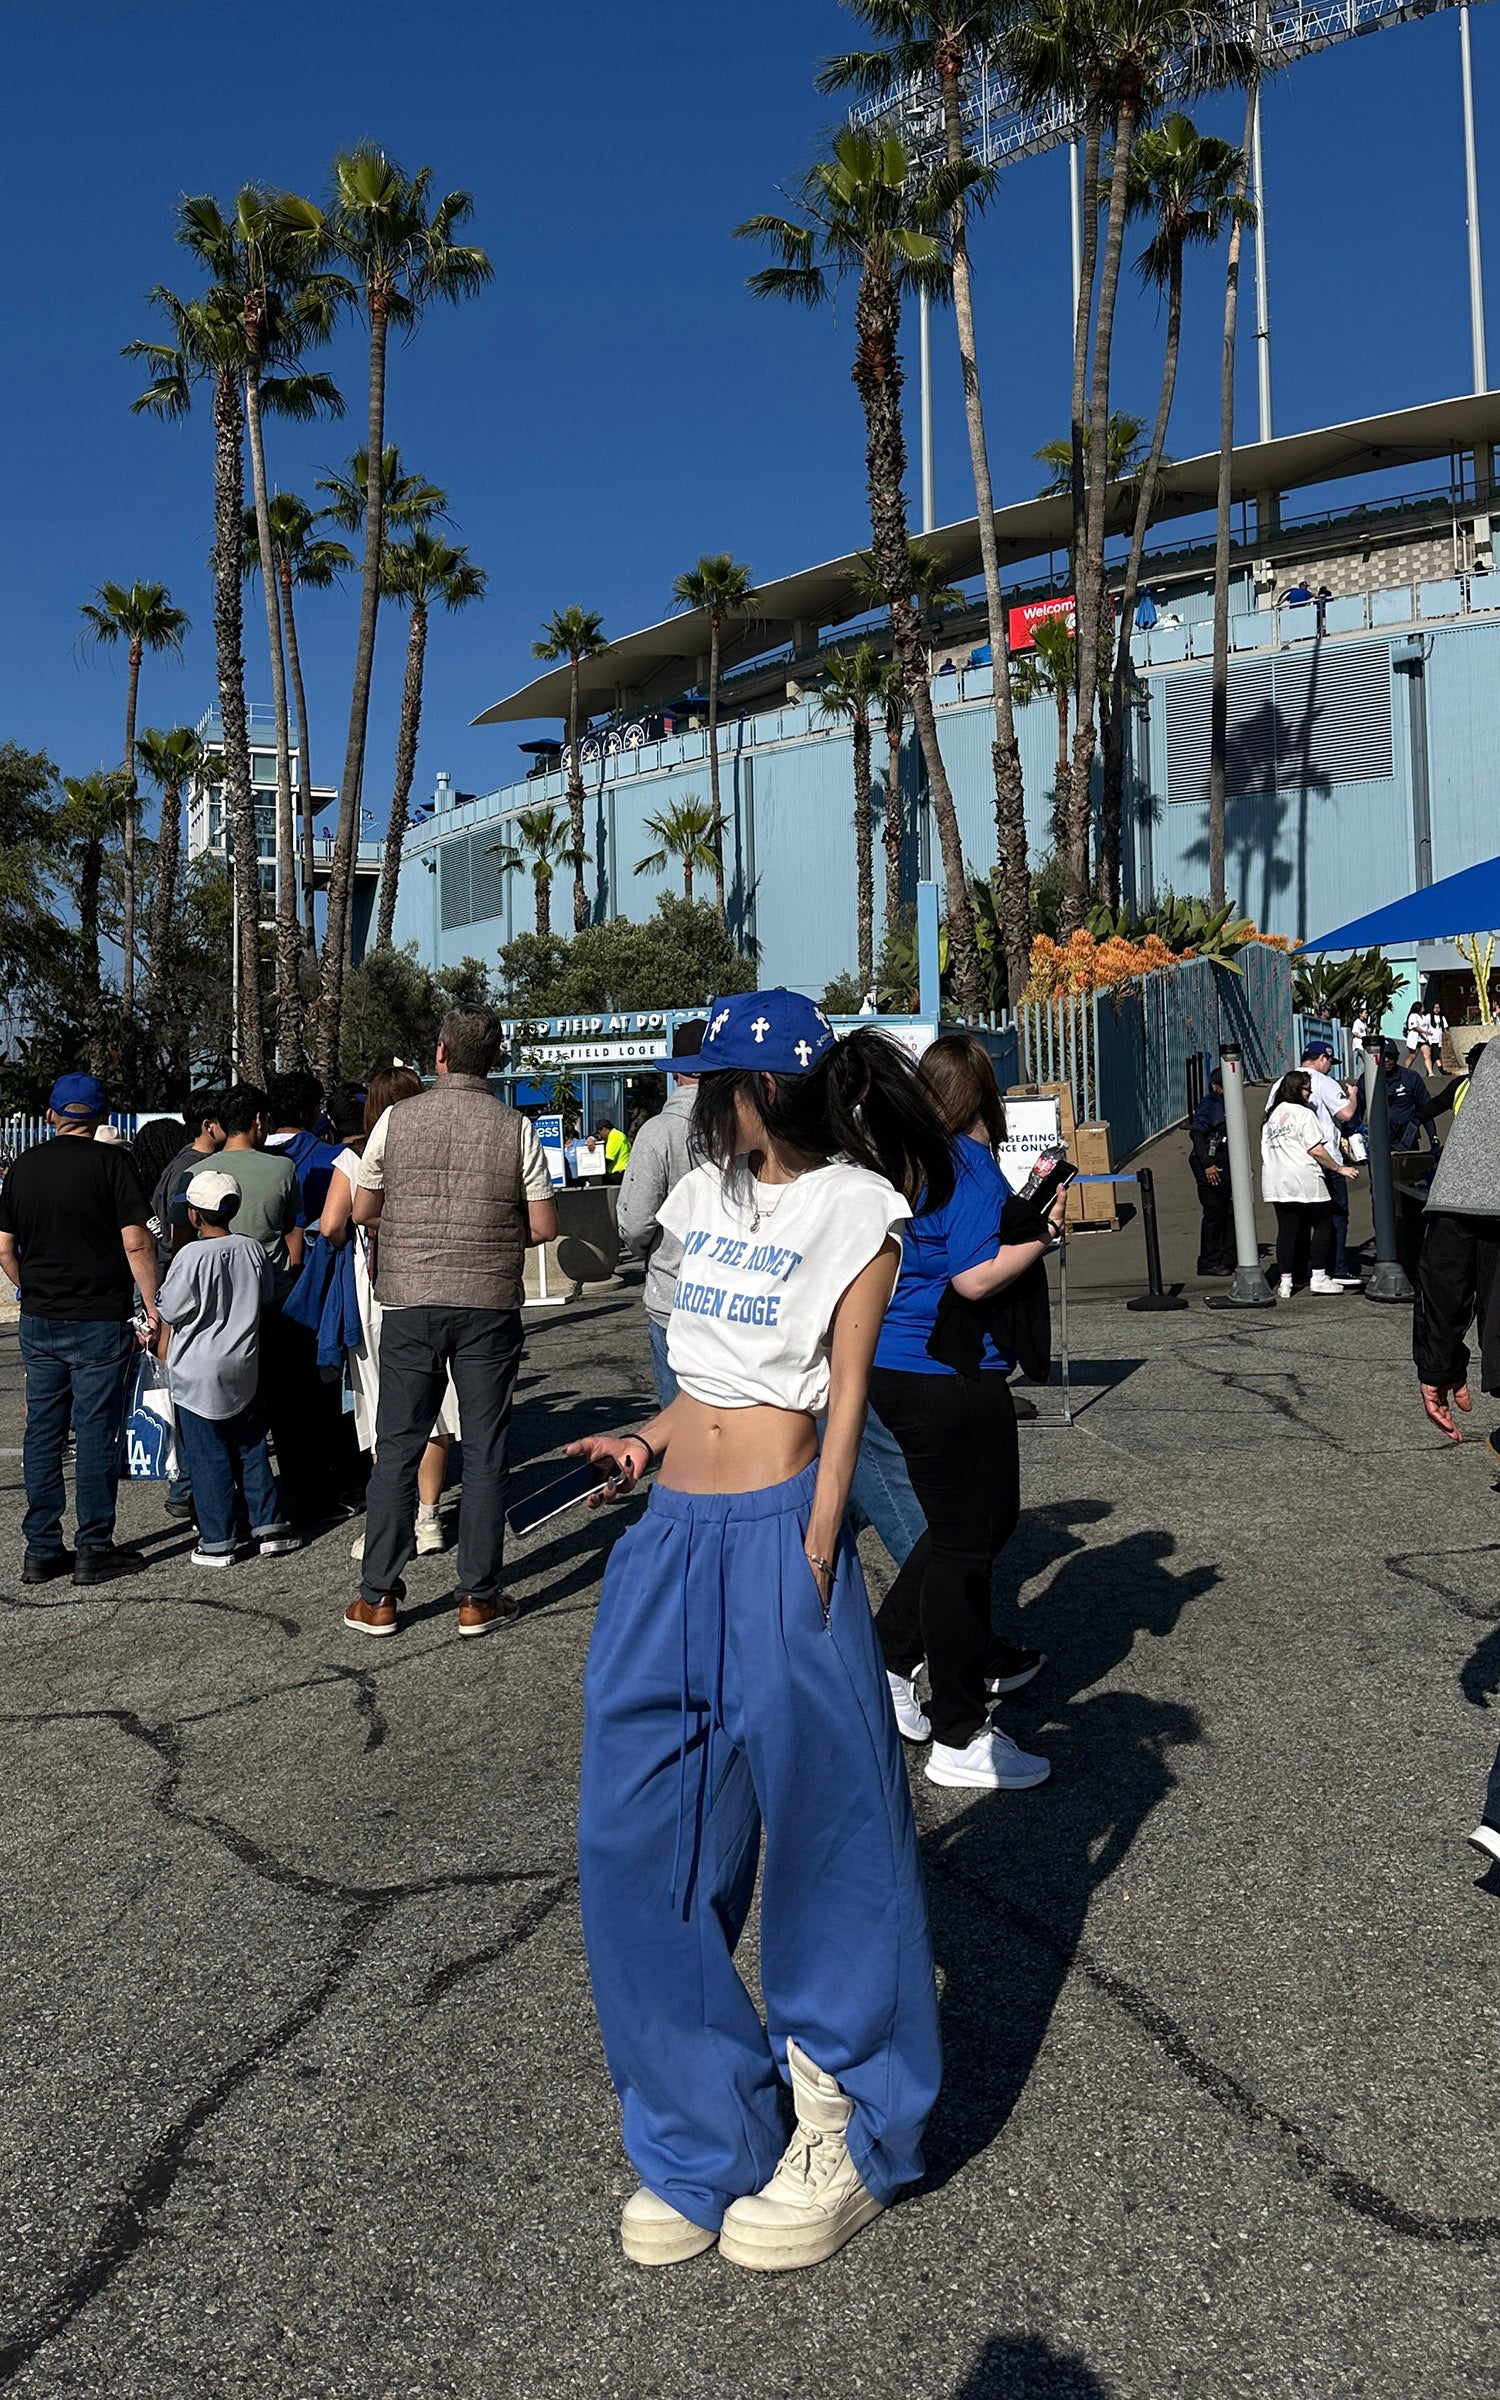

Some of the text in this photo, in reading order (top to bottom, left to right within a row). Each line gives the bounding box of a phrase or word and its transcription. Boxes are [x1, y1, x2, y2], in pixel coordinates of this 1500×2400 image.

[557, 1018, 602, 1032] FIELD
[609, 1016, 628, 1029] AT
[570, 1048, 609, 1058] FIELD
[620, 1046, 655, 1056] LOGE
[535, 1127, 559, 1138] ess
[1009, 1134, 1056, 1143] SEATING
[999, 1144, 1050, 1153] NCE ONLY
[708, 1236, 748, 1266] THE
[674, 1280, 781, 1326] ARDEN EDGE
[126, 1429, 151, 1475] LA
